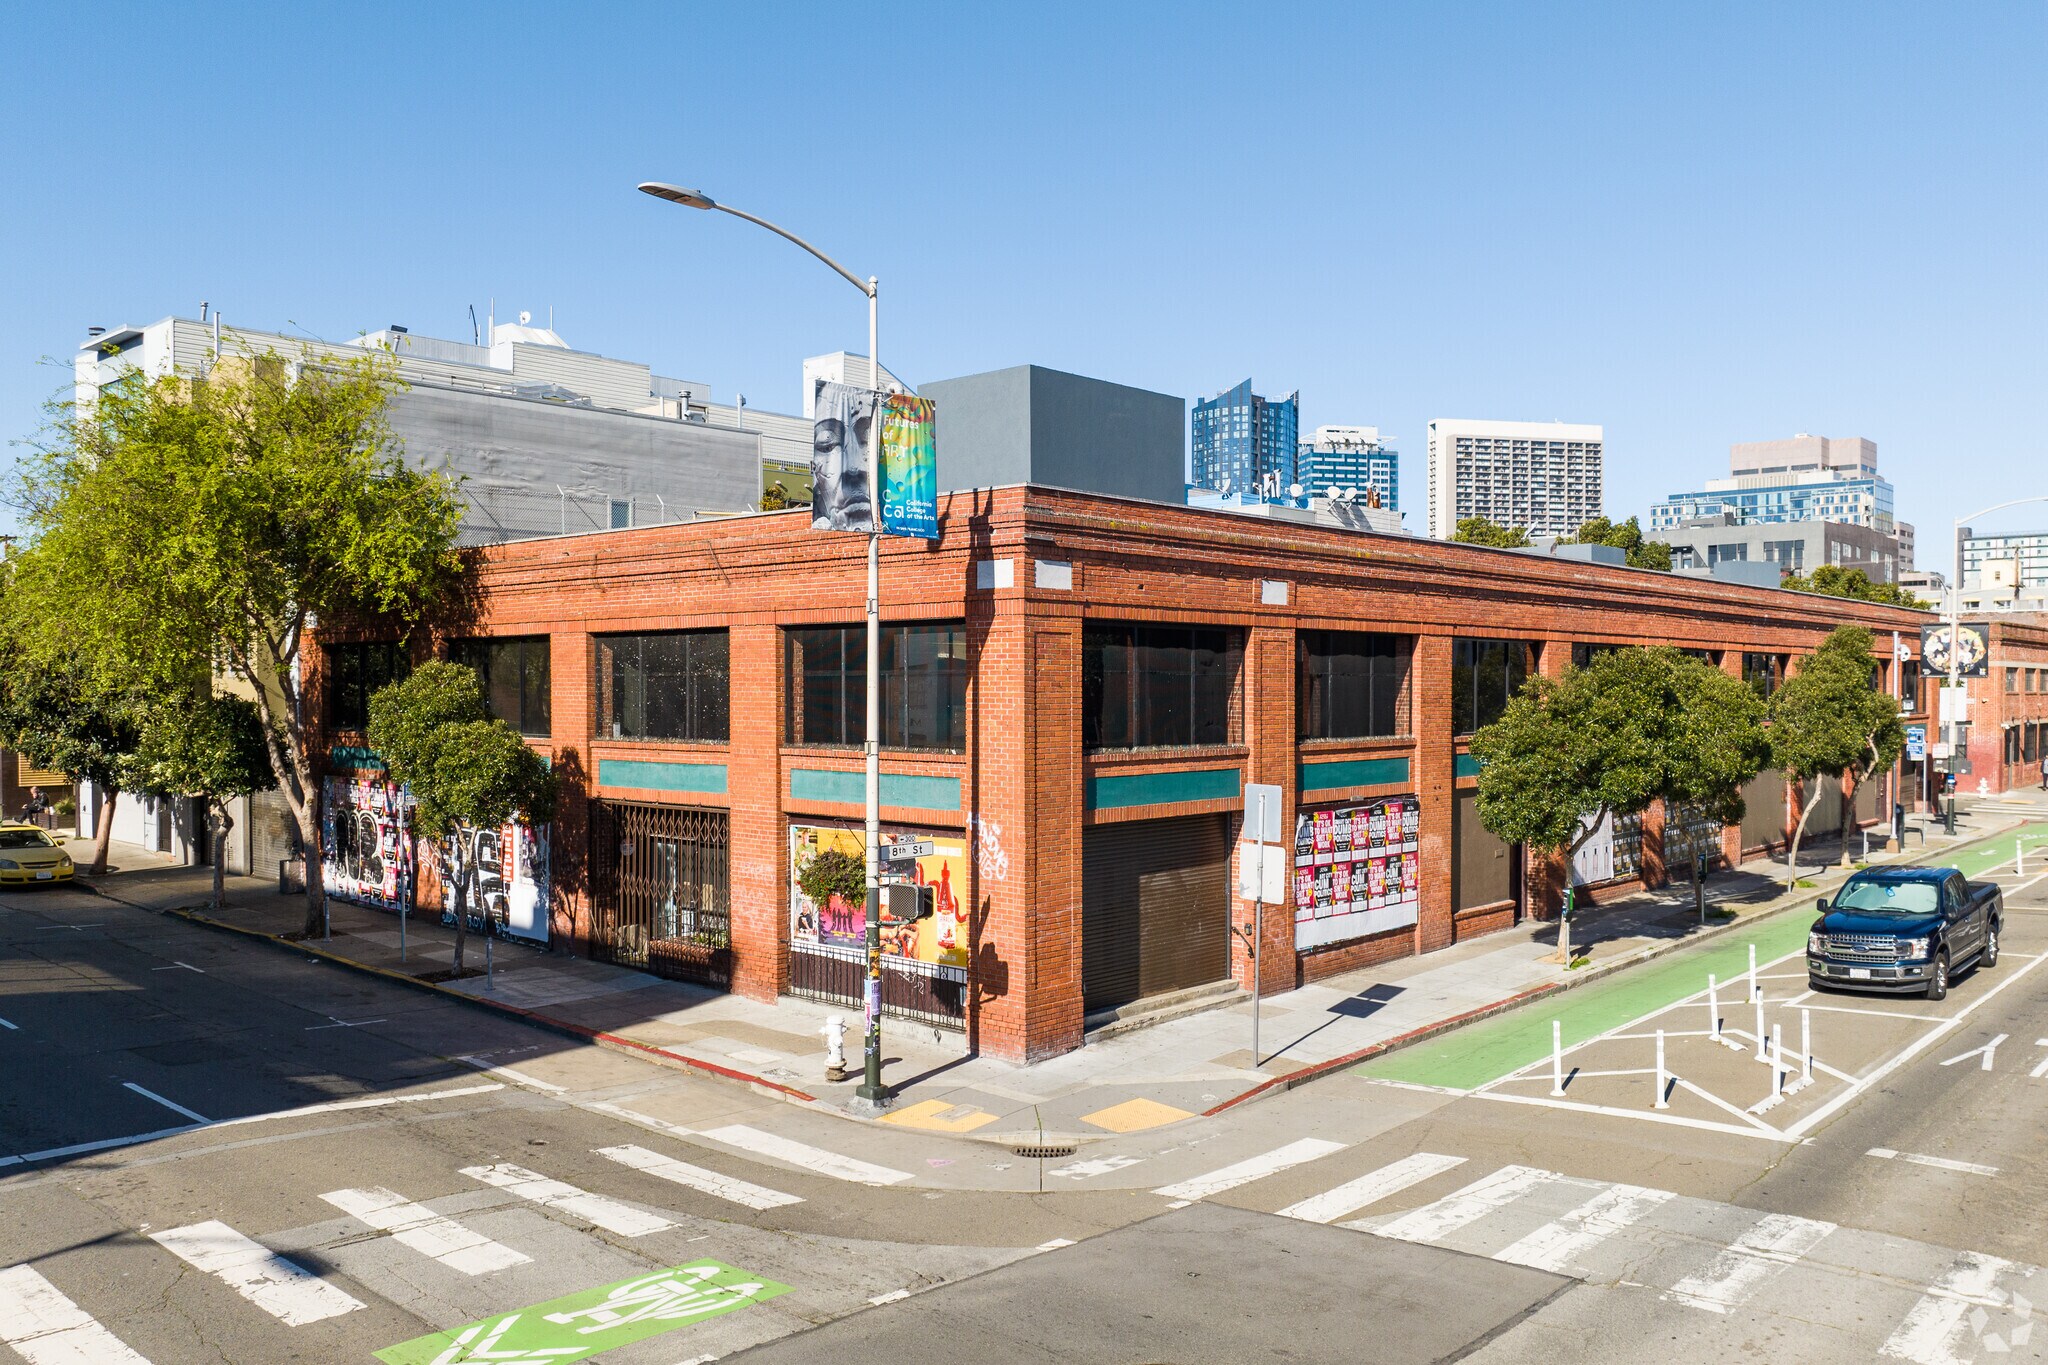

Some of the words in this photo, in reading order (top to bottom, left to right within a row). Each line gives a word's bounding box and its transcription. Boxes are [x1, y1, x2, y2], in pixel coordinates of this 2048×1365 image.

[883, 415, 918, 429] Futures
[882, 430, 892, 440] of
[881, 444, 908, 458] ART
[906, 500, 932, 508] California
[906, 506, 926, 514] College
[892, 847, 906, 856] 8th
[913, 845, 922, 854] St
